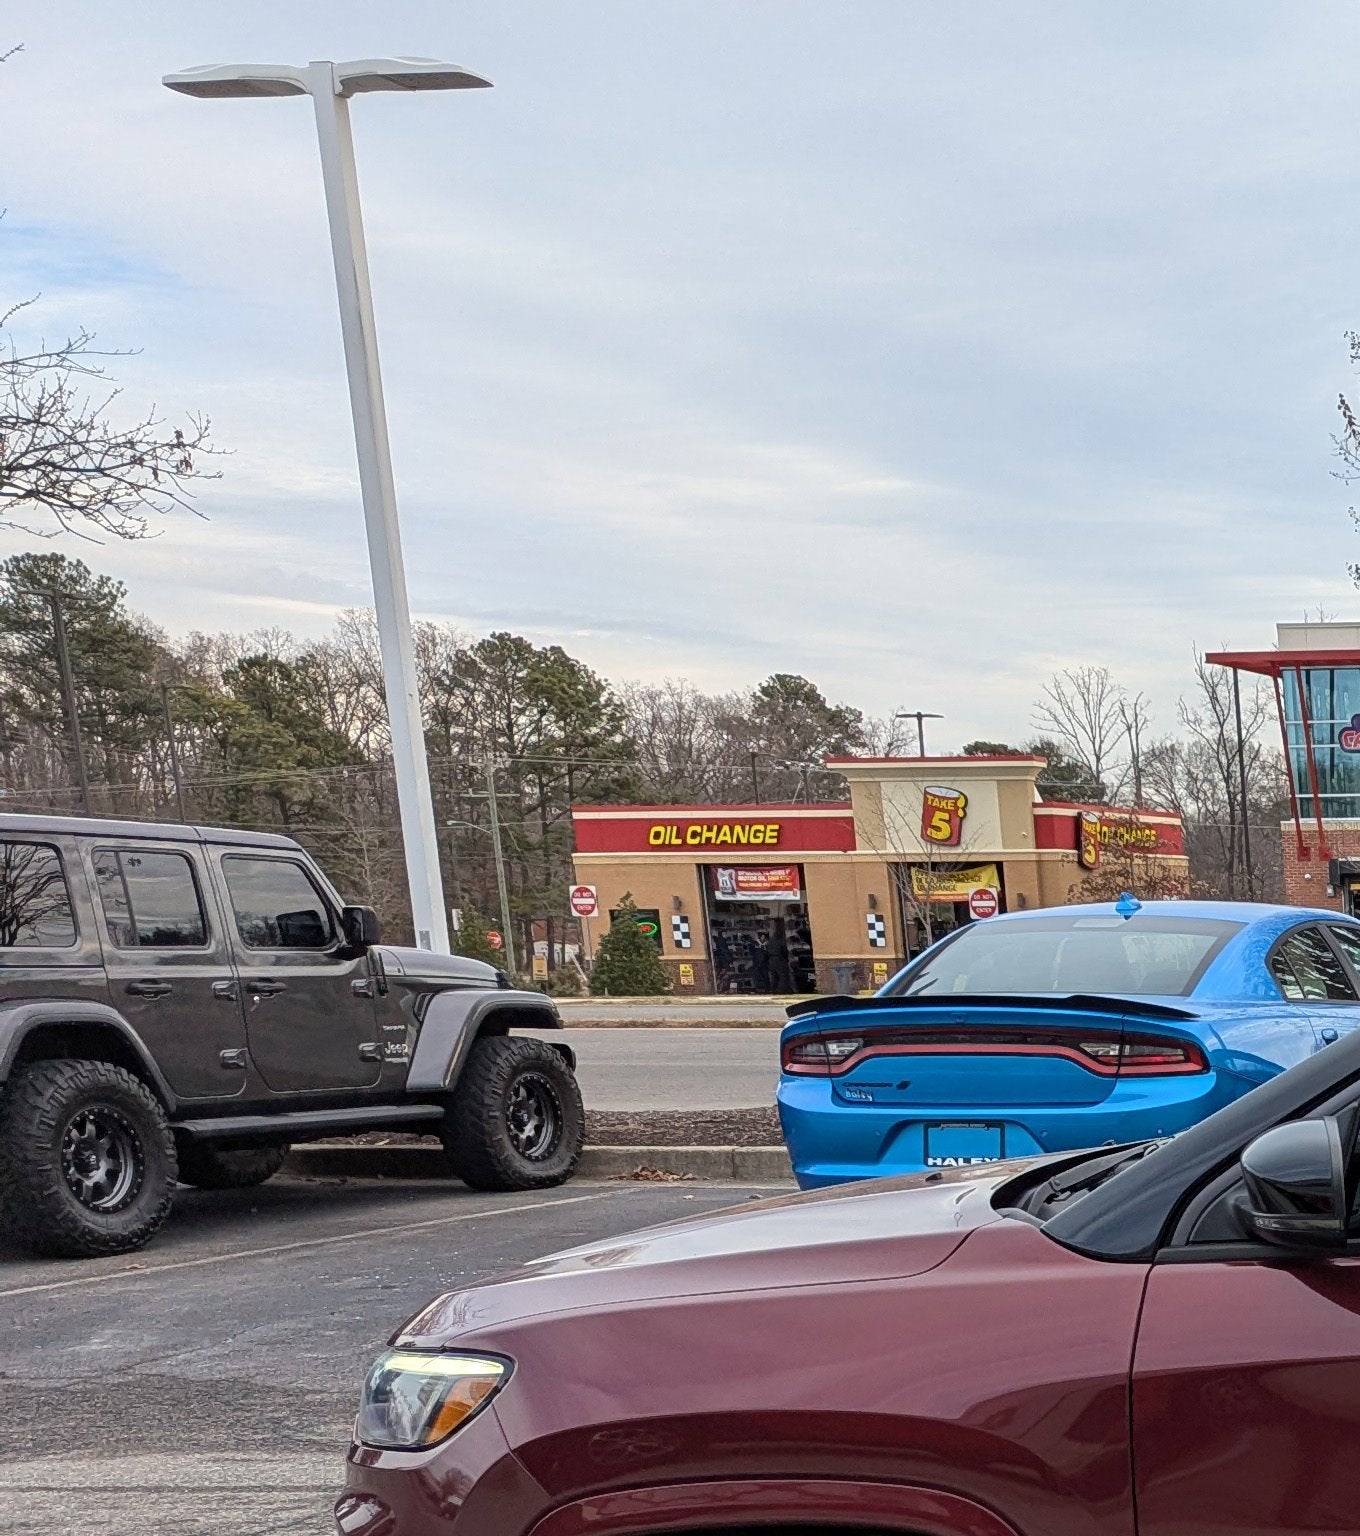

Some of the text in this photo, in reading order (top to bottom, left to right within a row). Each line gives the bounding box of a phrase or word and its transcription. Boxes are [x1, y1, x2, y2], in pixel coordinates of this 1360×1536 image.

[926, 794, 956, 810] TAKE
[926, 810, 951, 840] 5
[649, 824, 779, 845] OIL CHANGE
[384, 1041, 409, 1056] Jeep
